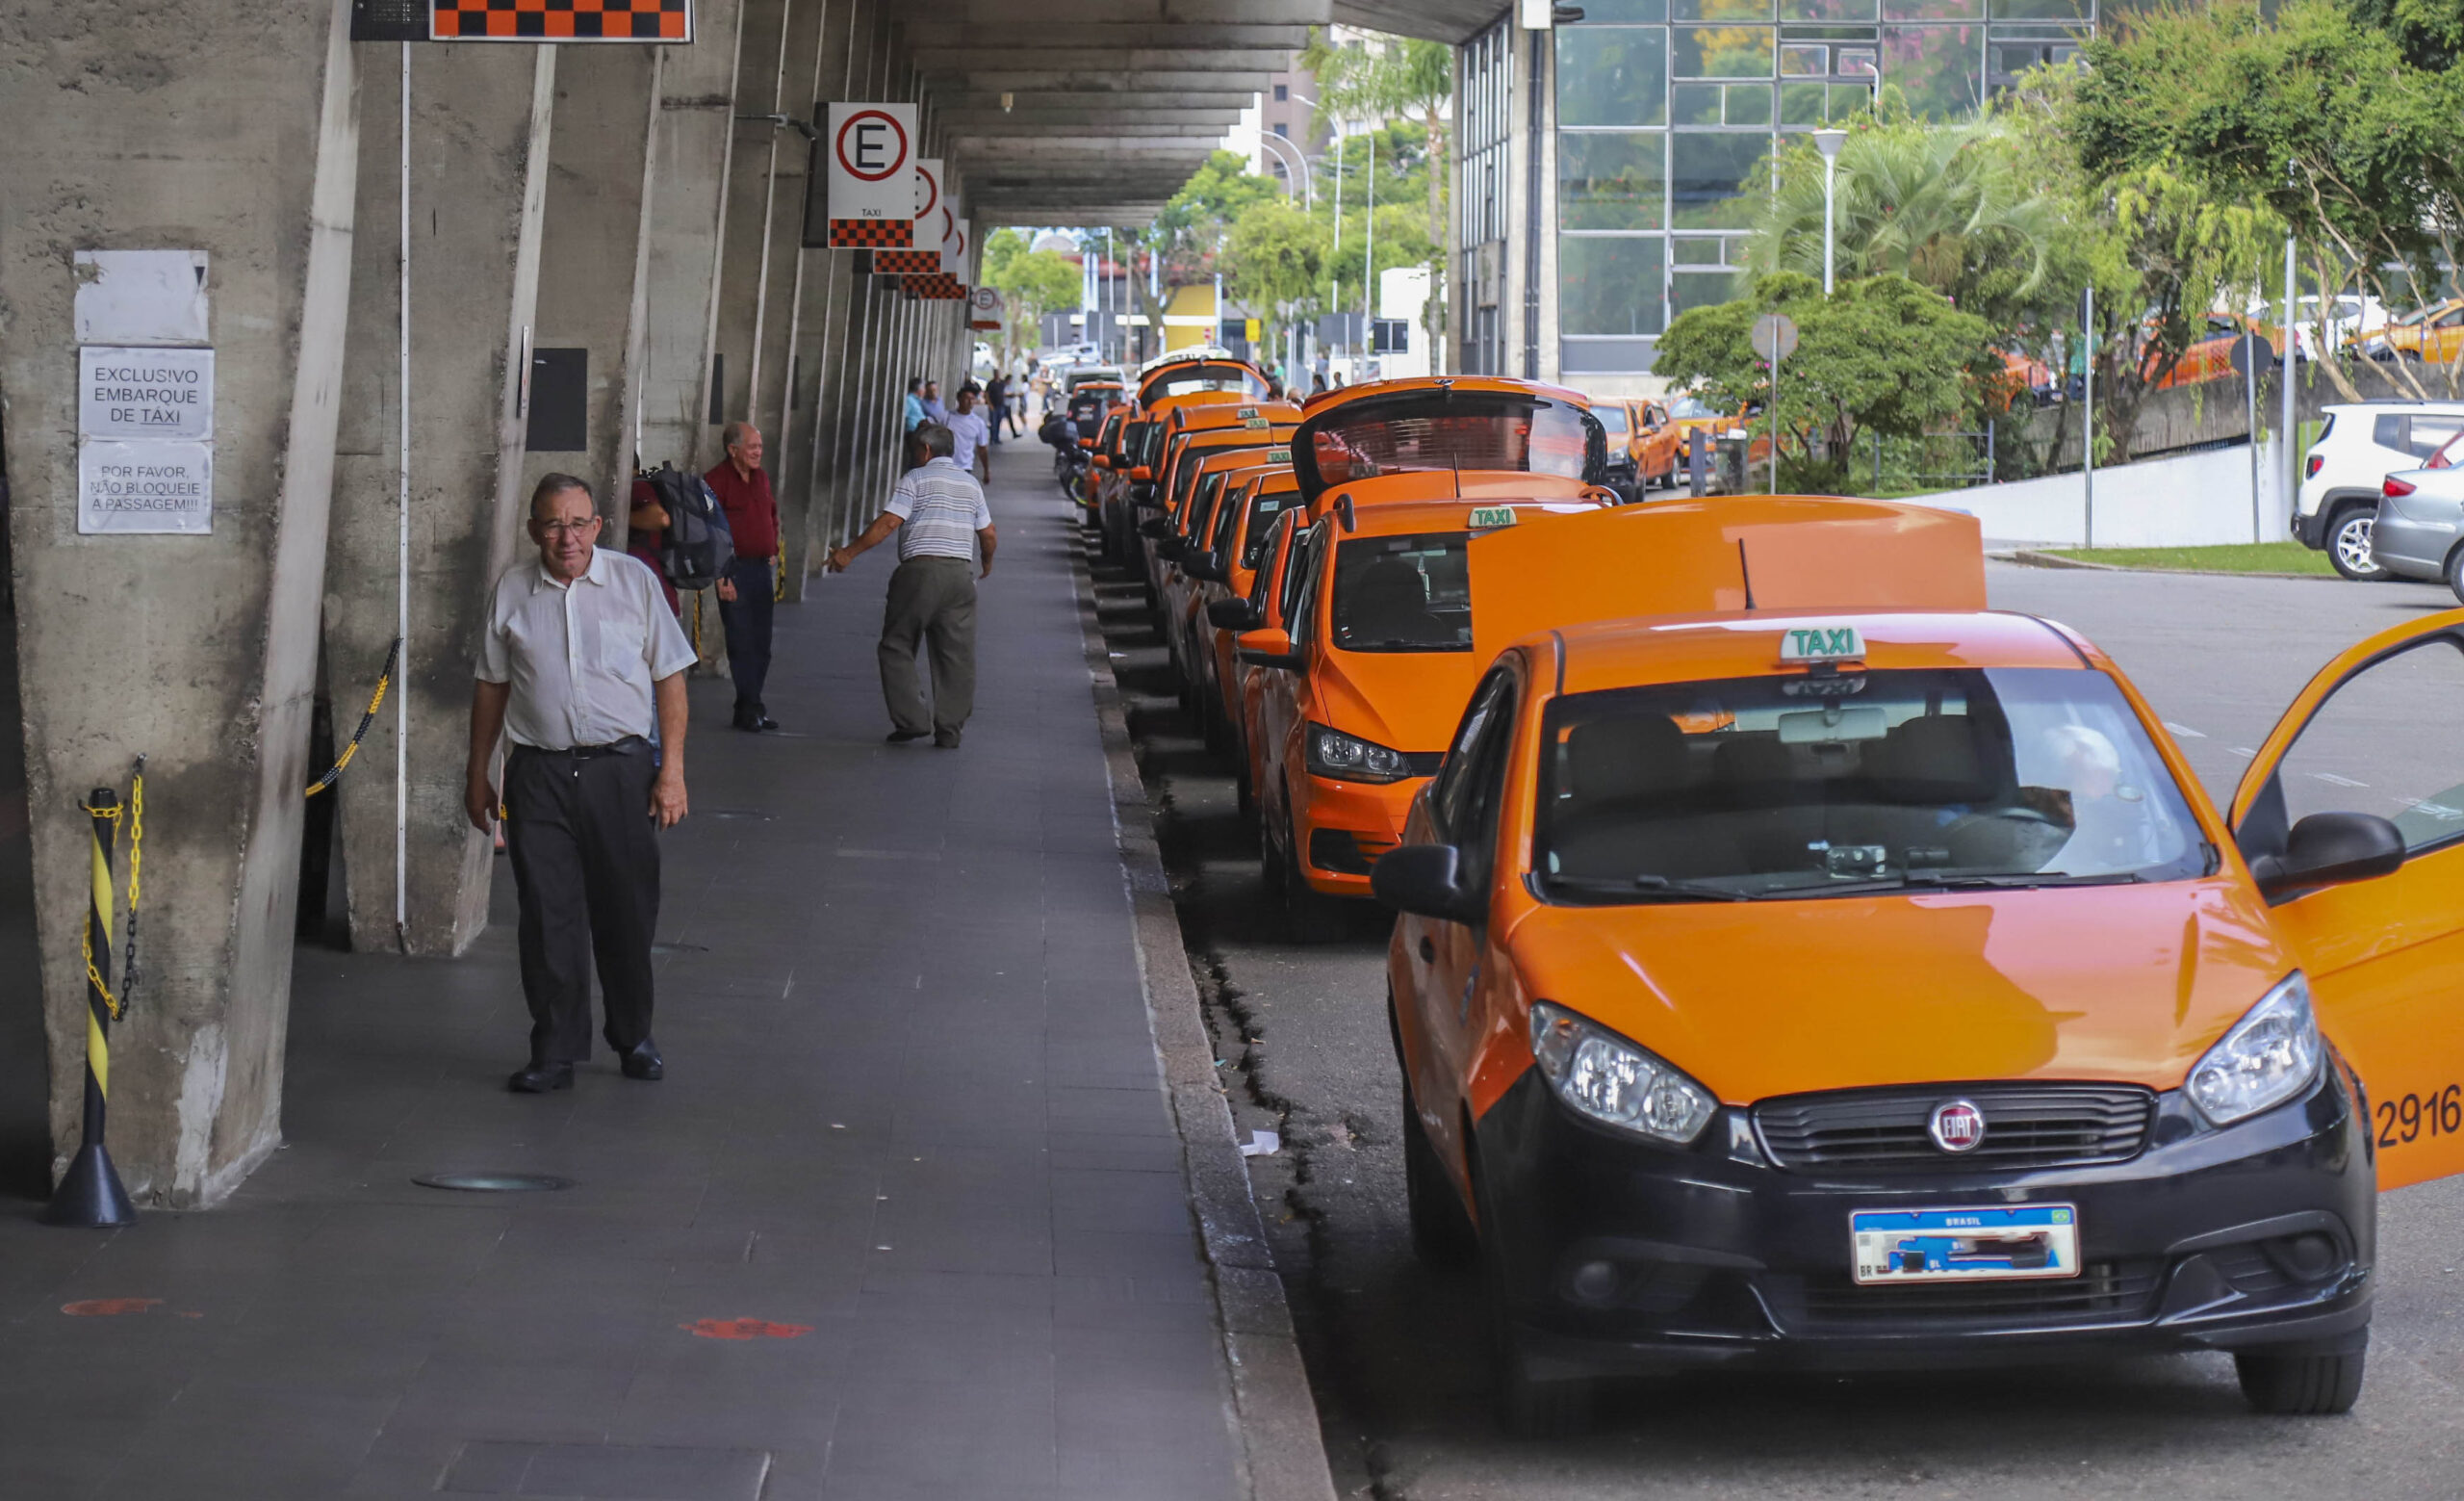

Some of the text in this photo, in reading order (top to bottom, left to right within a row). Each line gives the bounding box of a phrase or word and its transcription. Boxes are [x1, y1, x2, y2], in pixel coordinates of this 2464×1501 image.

[857, 124, 886, 168] E
[94, 387, 198, 406] EMBARQUE
[111, 406, 181, 424] DE TÁXI
[1270, 452, 1291, 462] TAXI
[101, 466, 132, 479] POR
[90, 479, 201, 496] NÃO BLOQUEIE
[91, 498, 198, 511] A PASSAGEM!!!
[1475, 508, 1511, 525] TAXI
[1790, 628, 1855, 656] TAXI
[2377, 1084, 2462, 1149] 2916
[1943, 1115, 1973, 1139] FIAT
[1945, 1217, 1982, 1227] BRASIL
[1860, 1264, 1873, 1278] BR
